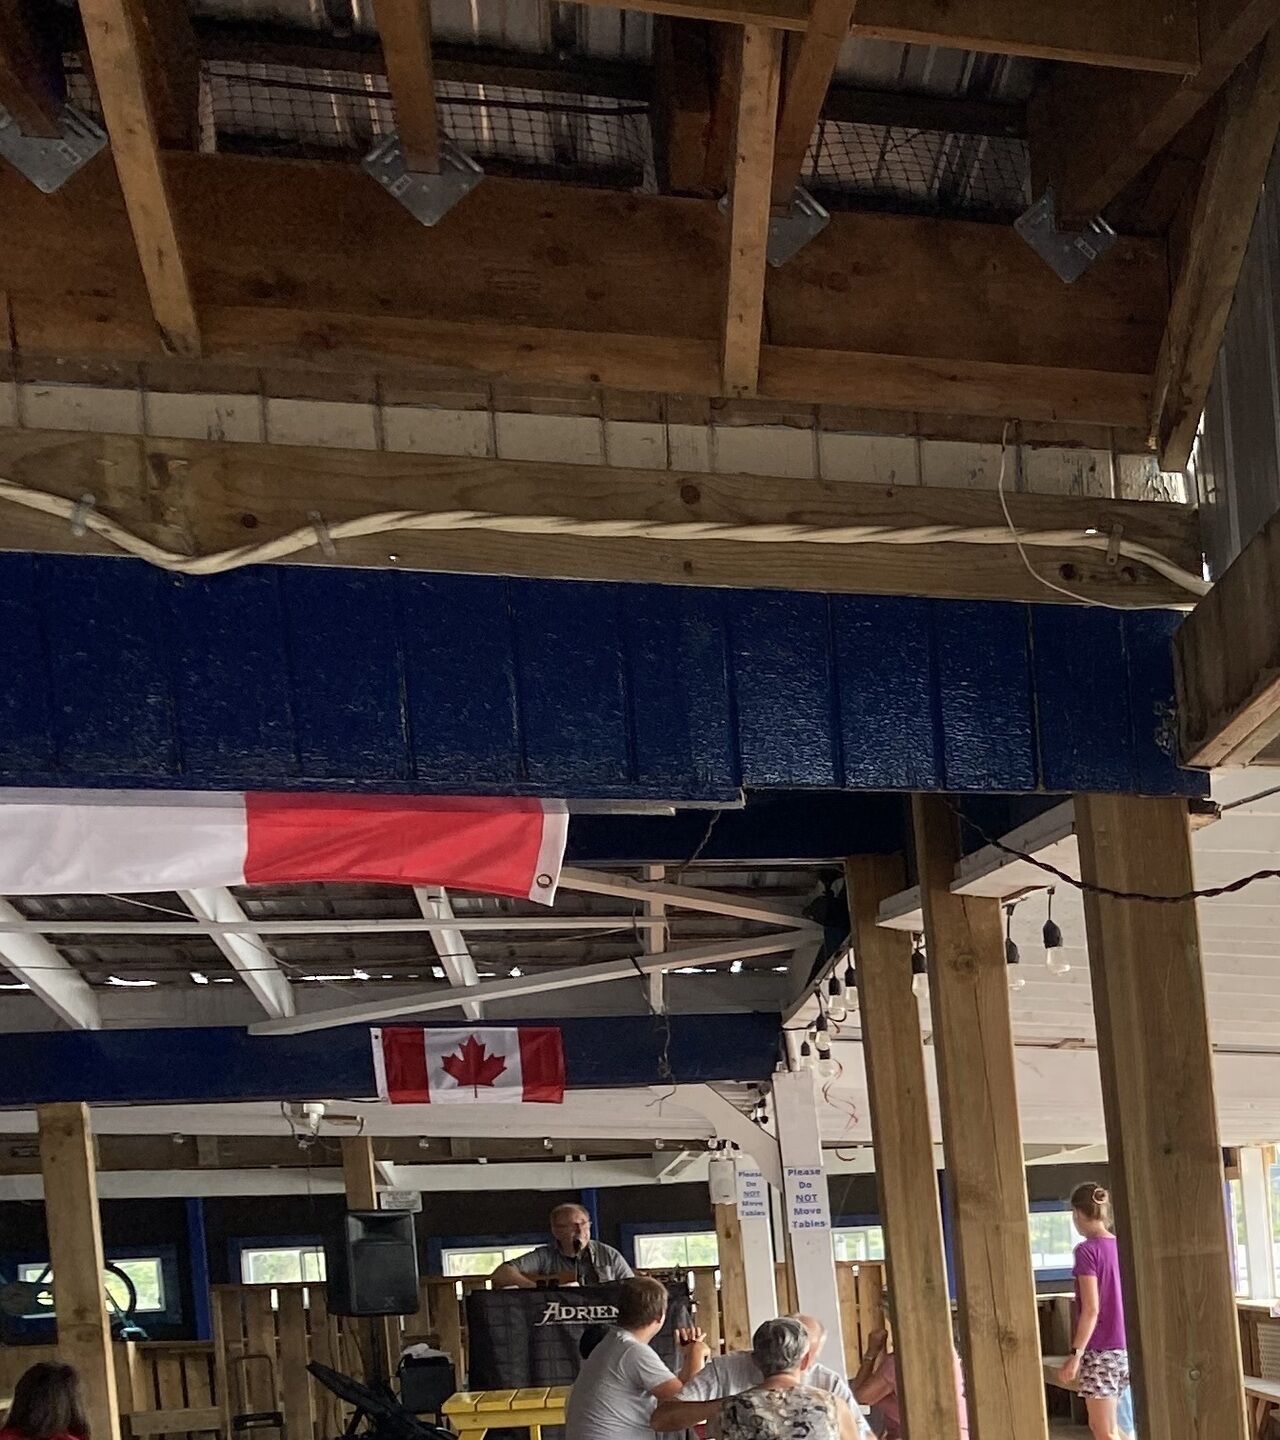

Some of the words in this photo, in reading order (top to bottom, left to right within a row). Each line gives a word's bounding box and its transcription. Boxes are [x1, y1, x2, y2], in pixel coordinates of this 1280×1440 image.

[787, 1168, 821, 1176] Please
[798, 1181, 812, 1189] Do
[795, 1194, 818, 1203] NOT
[791, 1220, 826, 1229] Tables
